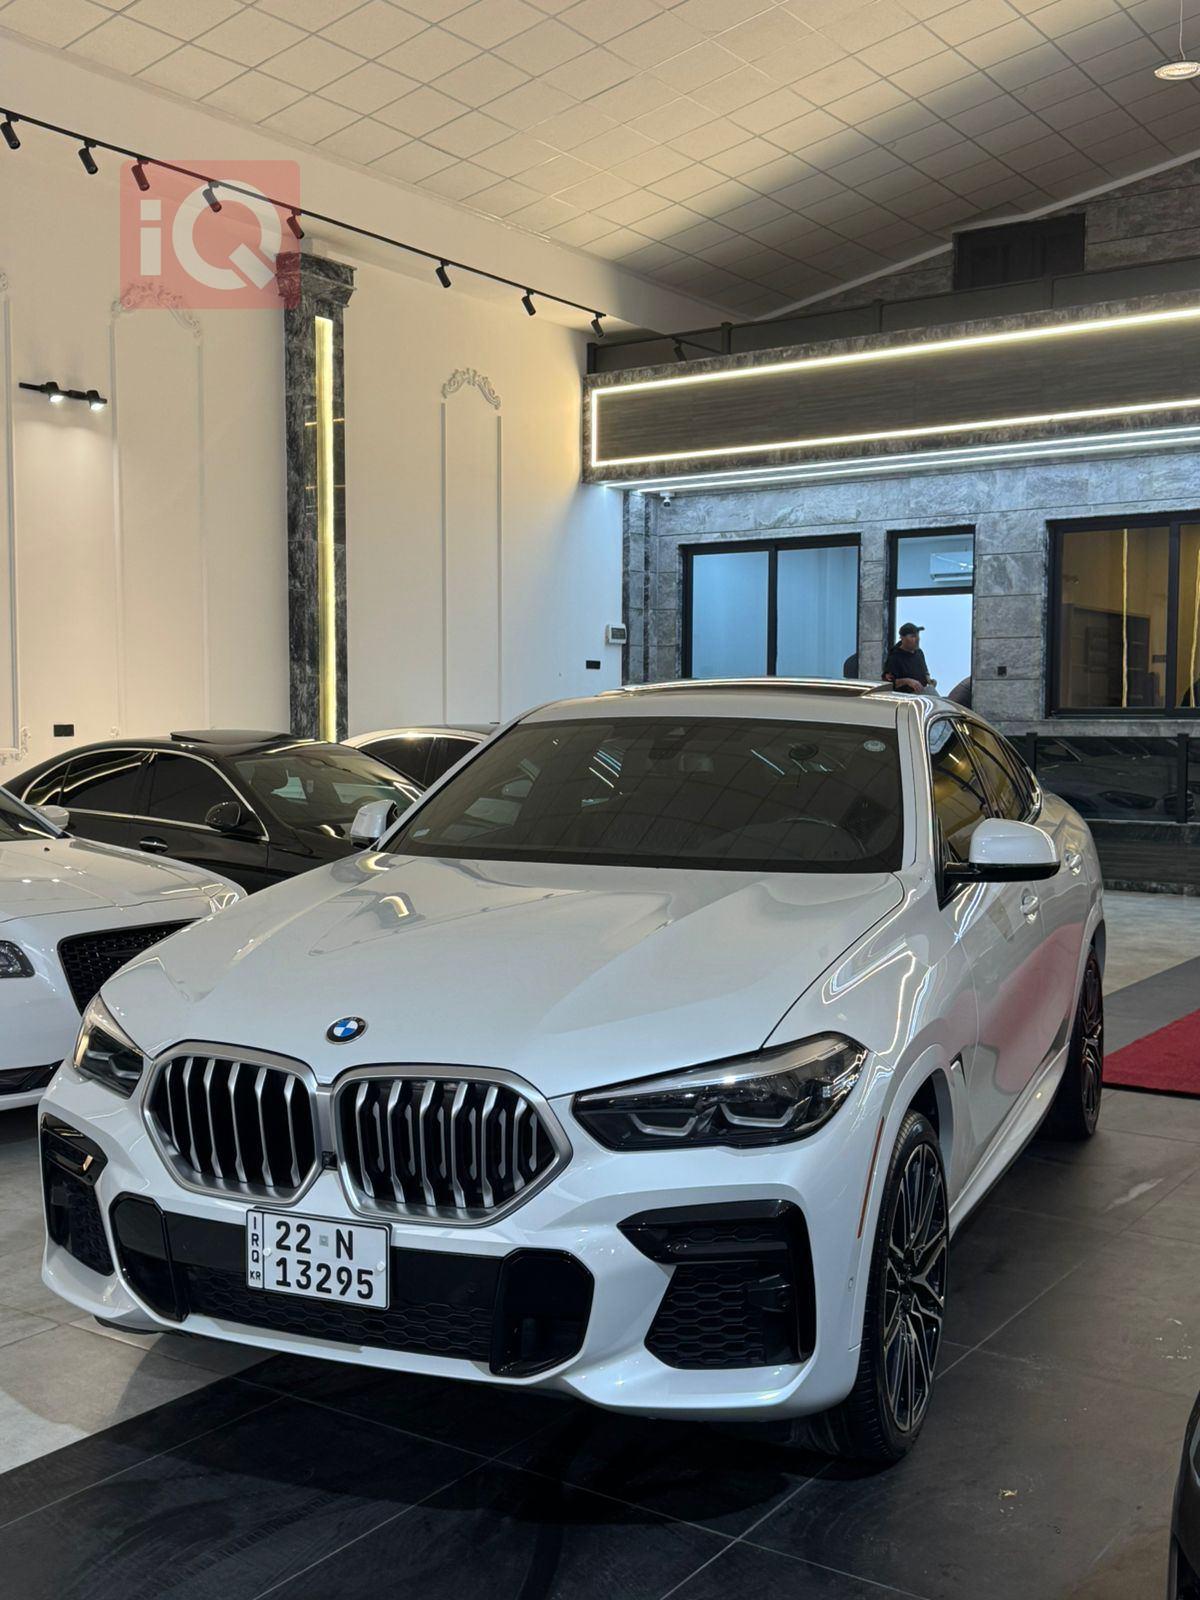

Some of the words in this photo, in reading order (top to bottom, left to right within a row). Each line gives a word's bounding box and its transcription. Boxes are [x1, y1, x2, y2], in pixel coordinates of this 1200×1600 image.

[251, 1216, 260, 1263] IRQ
[276, 1220, 311, 1254] 22
[336, 1229, 353, 1260] N
[250, 1270, 261, 1280] KR
[276, 1257, 373, 1299] 13295
